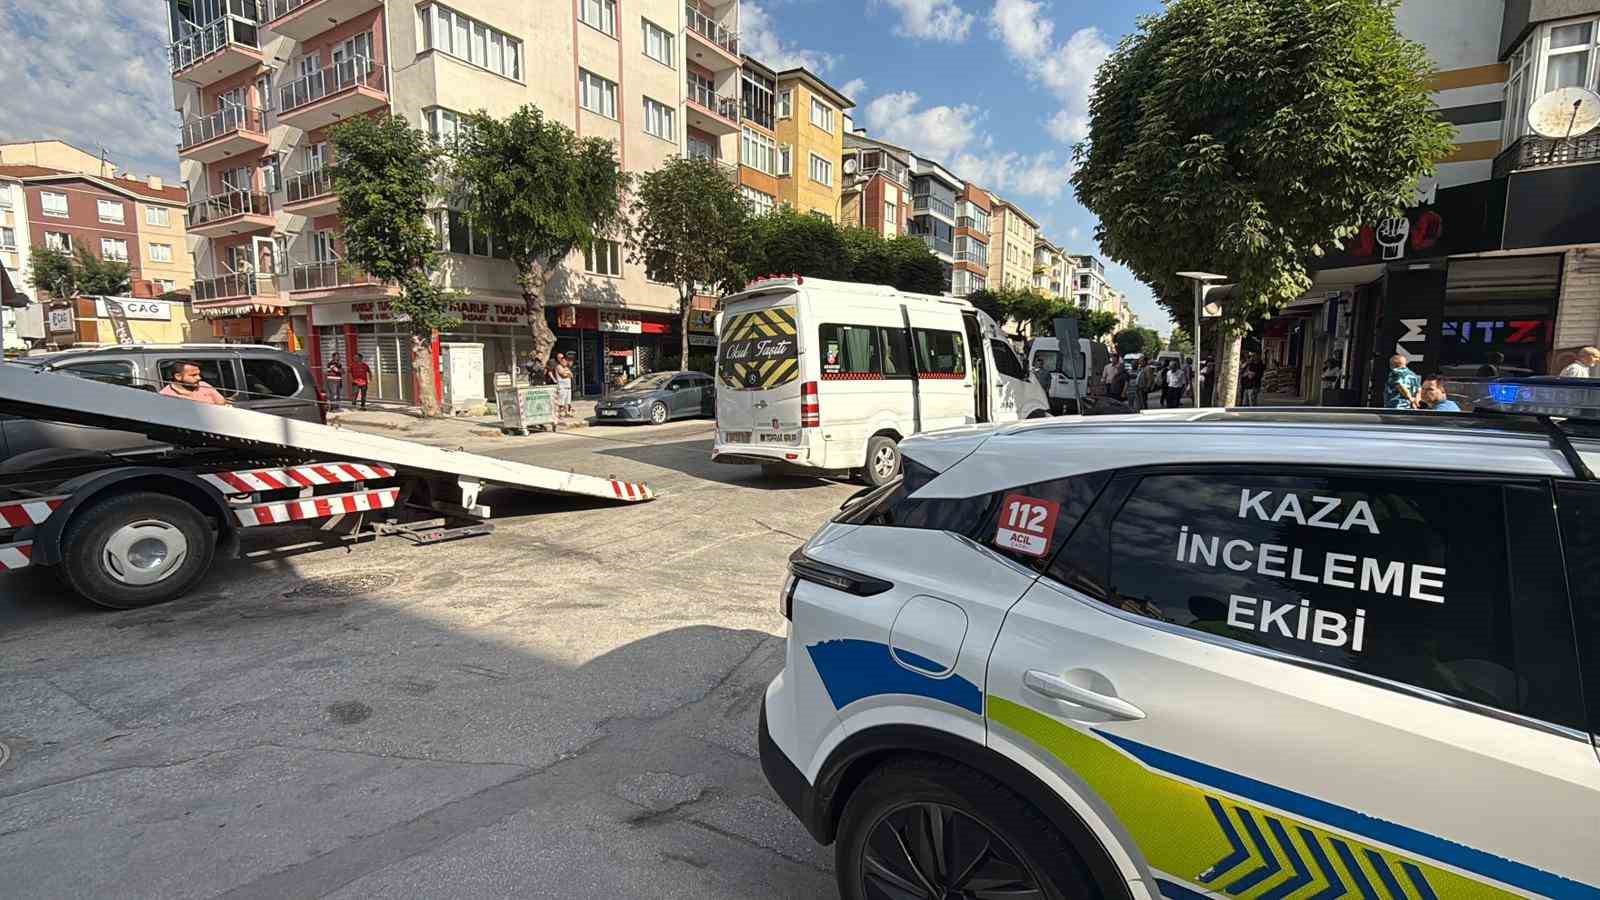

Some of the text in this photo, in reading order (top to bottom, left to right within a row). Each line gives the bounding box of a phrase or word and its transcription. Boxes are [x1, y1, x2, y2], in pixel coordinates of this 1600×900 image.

[449, 302, 489, 314] MARUF
[727, 342, 751, 359] Okul
[1008, 501, 1048, 533] 112
[1238, 488, 1380, 534] KAZA
[1176, 525, 1447, 604] İNCELEME
[1227, 594, 1367, 652] EKİBİ
